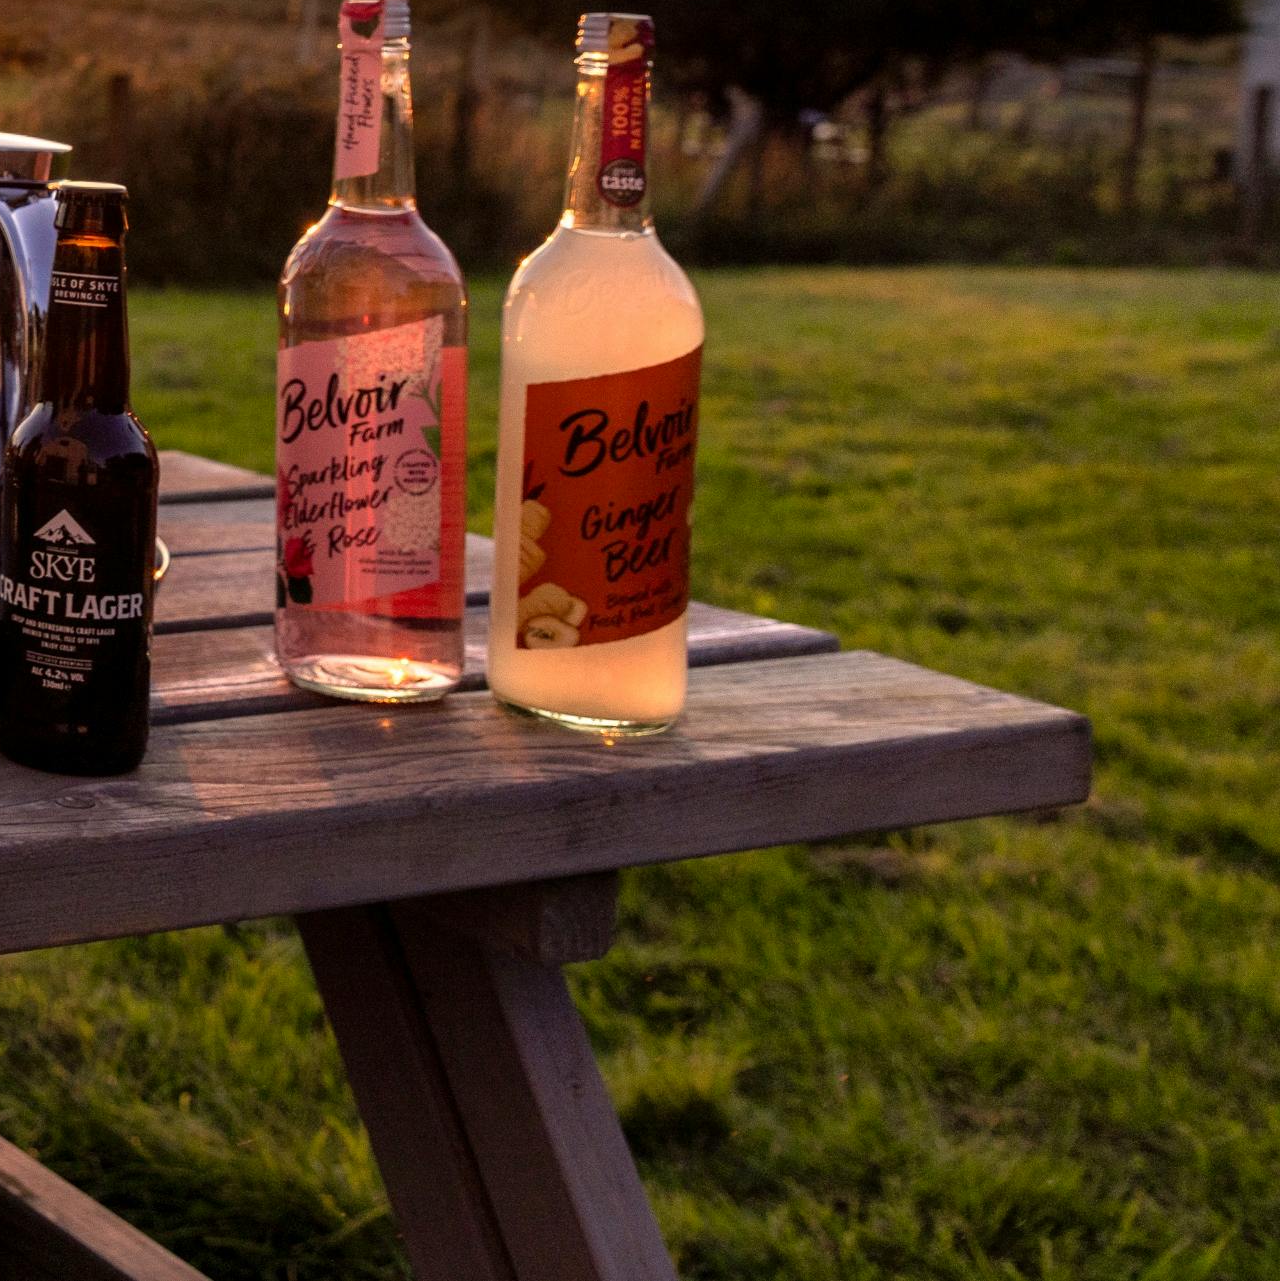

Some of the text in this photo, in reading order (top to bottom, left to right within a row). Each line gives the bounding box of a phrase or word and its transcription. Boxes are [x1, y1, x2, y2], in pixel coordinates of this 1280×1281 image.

[611, 85, 629, 137] 100%
[630, 77, 643, 150] NATURAL
[602, 175, 645, 191] taste
[52, 276, 119, 293] SLE OF SKYE
[54, 289, 92, 300] BREWING
[280, 372, 408, 444] Belvoir
[349, 417, 404, 447] Farm
[558, 398, 694, 478] Belvoir
[287, 453, 389, 499] Sparkling
[283, 485, 393, 531] Elderflower
[580, 483, 681, 541] Ginger
[328, 524, 382, 558] Rose
[600, 527, 678, 583] Beer
[30, 550, 96, 583] SKYE
[64, 592, 144, 620] LAGER
[76, 627, 96, 635] CRAFT
[96, 628, 116, 636] LAGER
[31, 666, 85, 682] ALC 4.2% VOL
